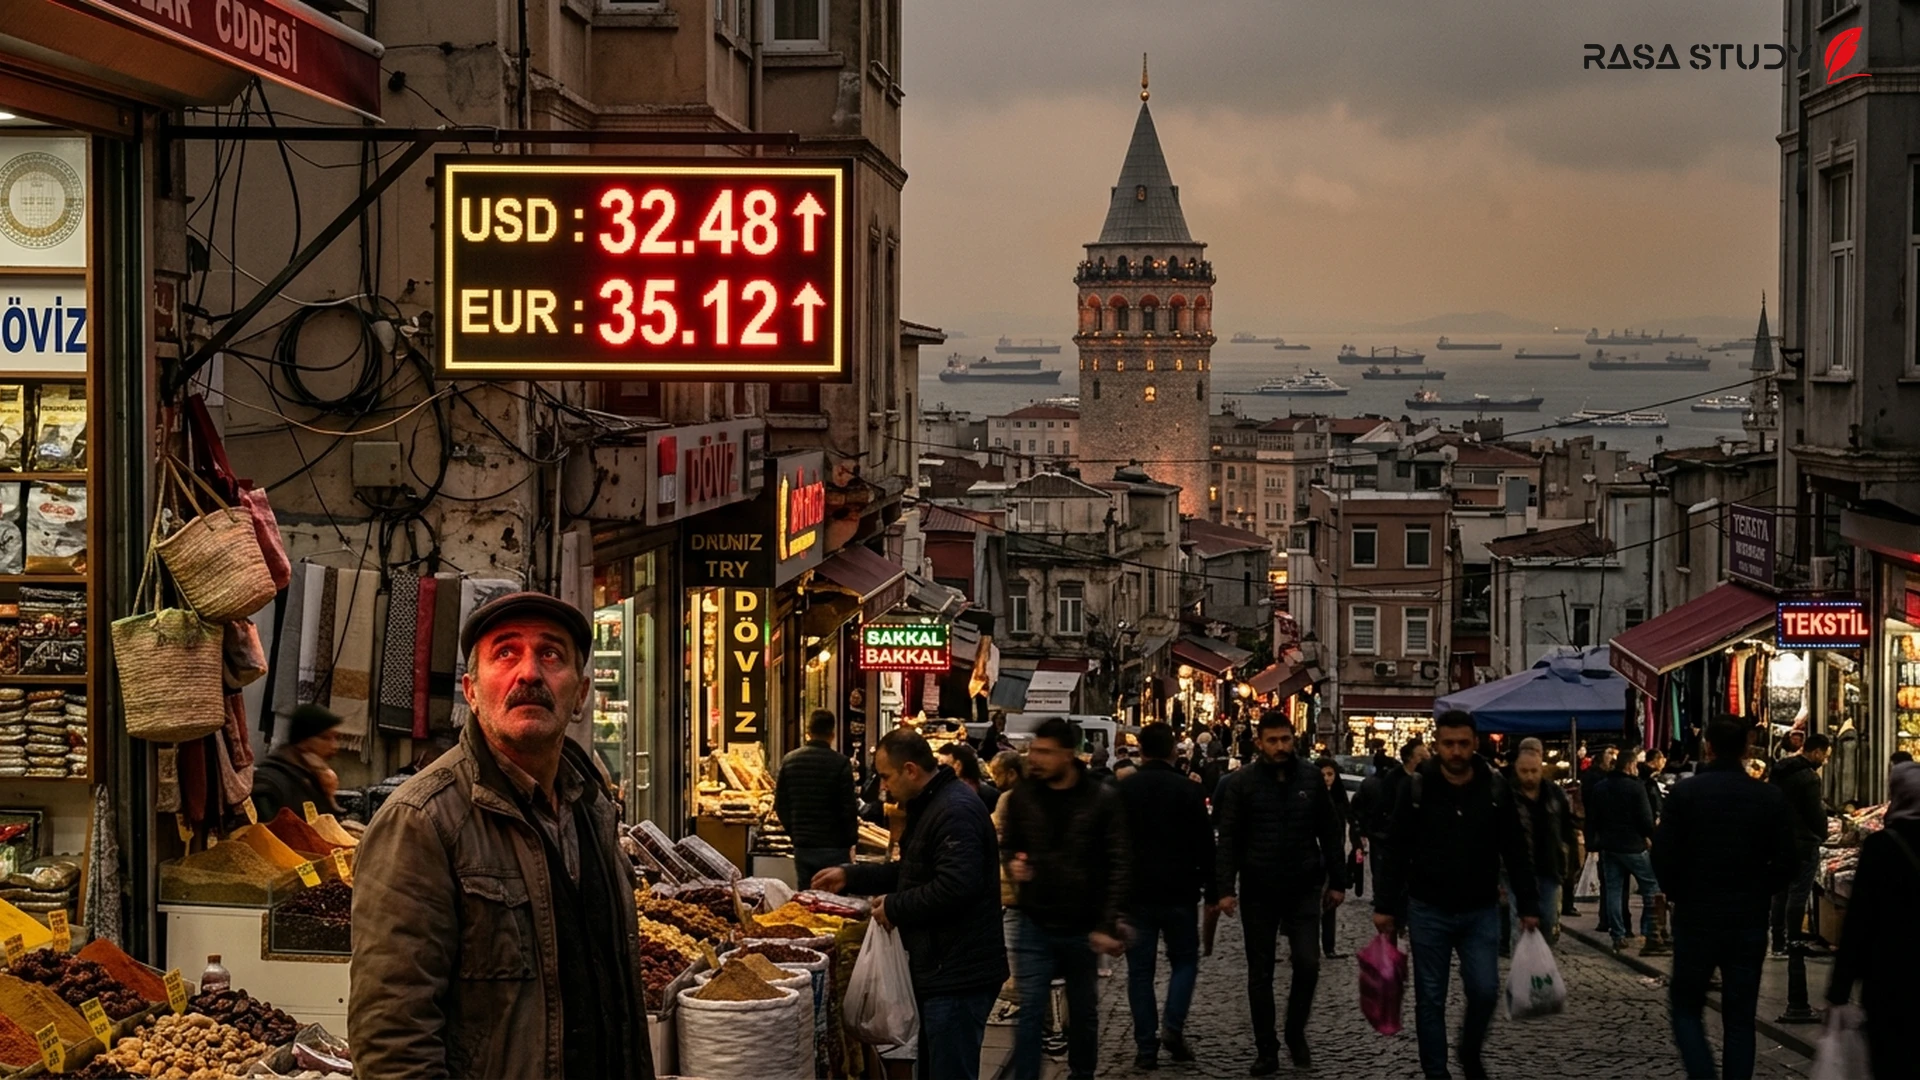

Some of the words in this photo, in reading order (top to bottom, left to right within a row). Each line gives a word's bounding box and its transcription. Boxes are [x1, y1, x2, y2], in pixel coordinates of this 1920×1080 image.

[461, 197, 557, 243] USD
[599, 188, 779, 256] 32.48
[461, 289, 558, 334] EUR
[599, 278, 779, 346] 35.12
[705, 560, 749, 578] TRY
[1782, 608, 1869, 635] TEKSTİL
[733, 590, 759, 733] DÖVİZ
[865, 648, 945, 665] BAKKAL
